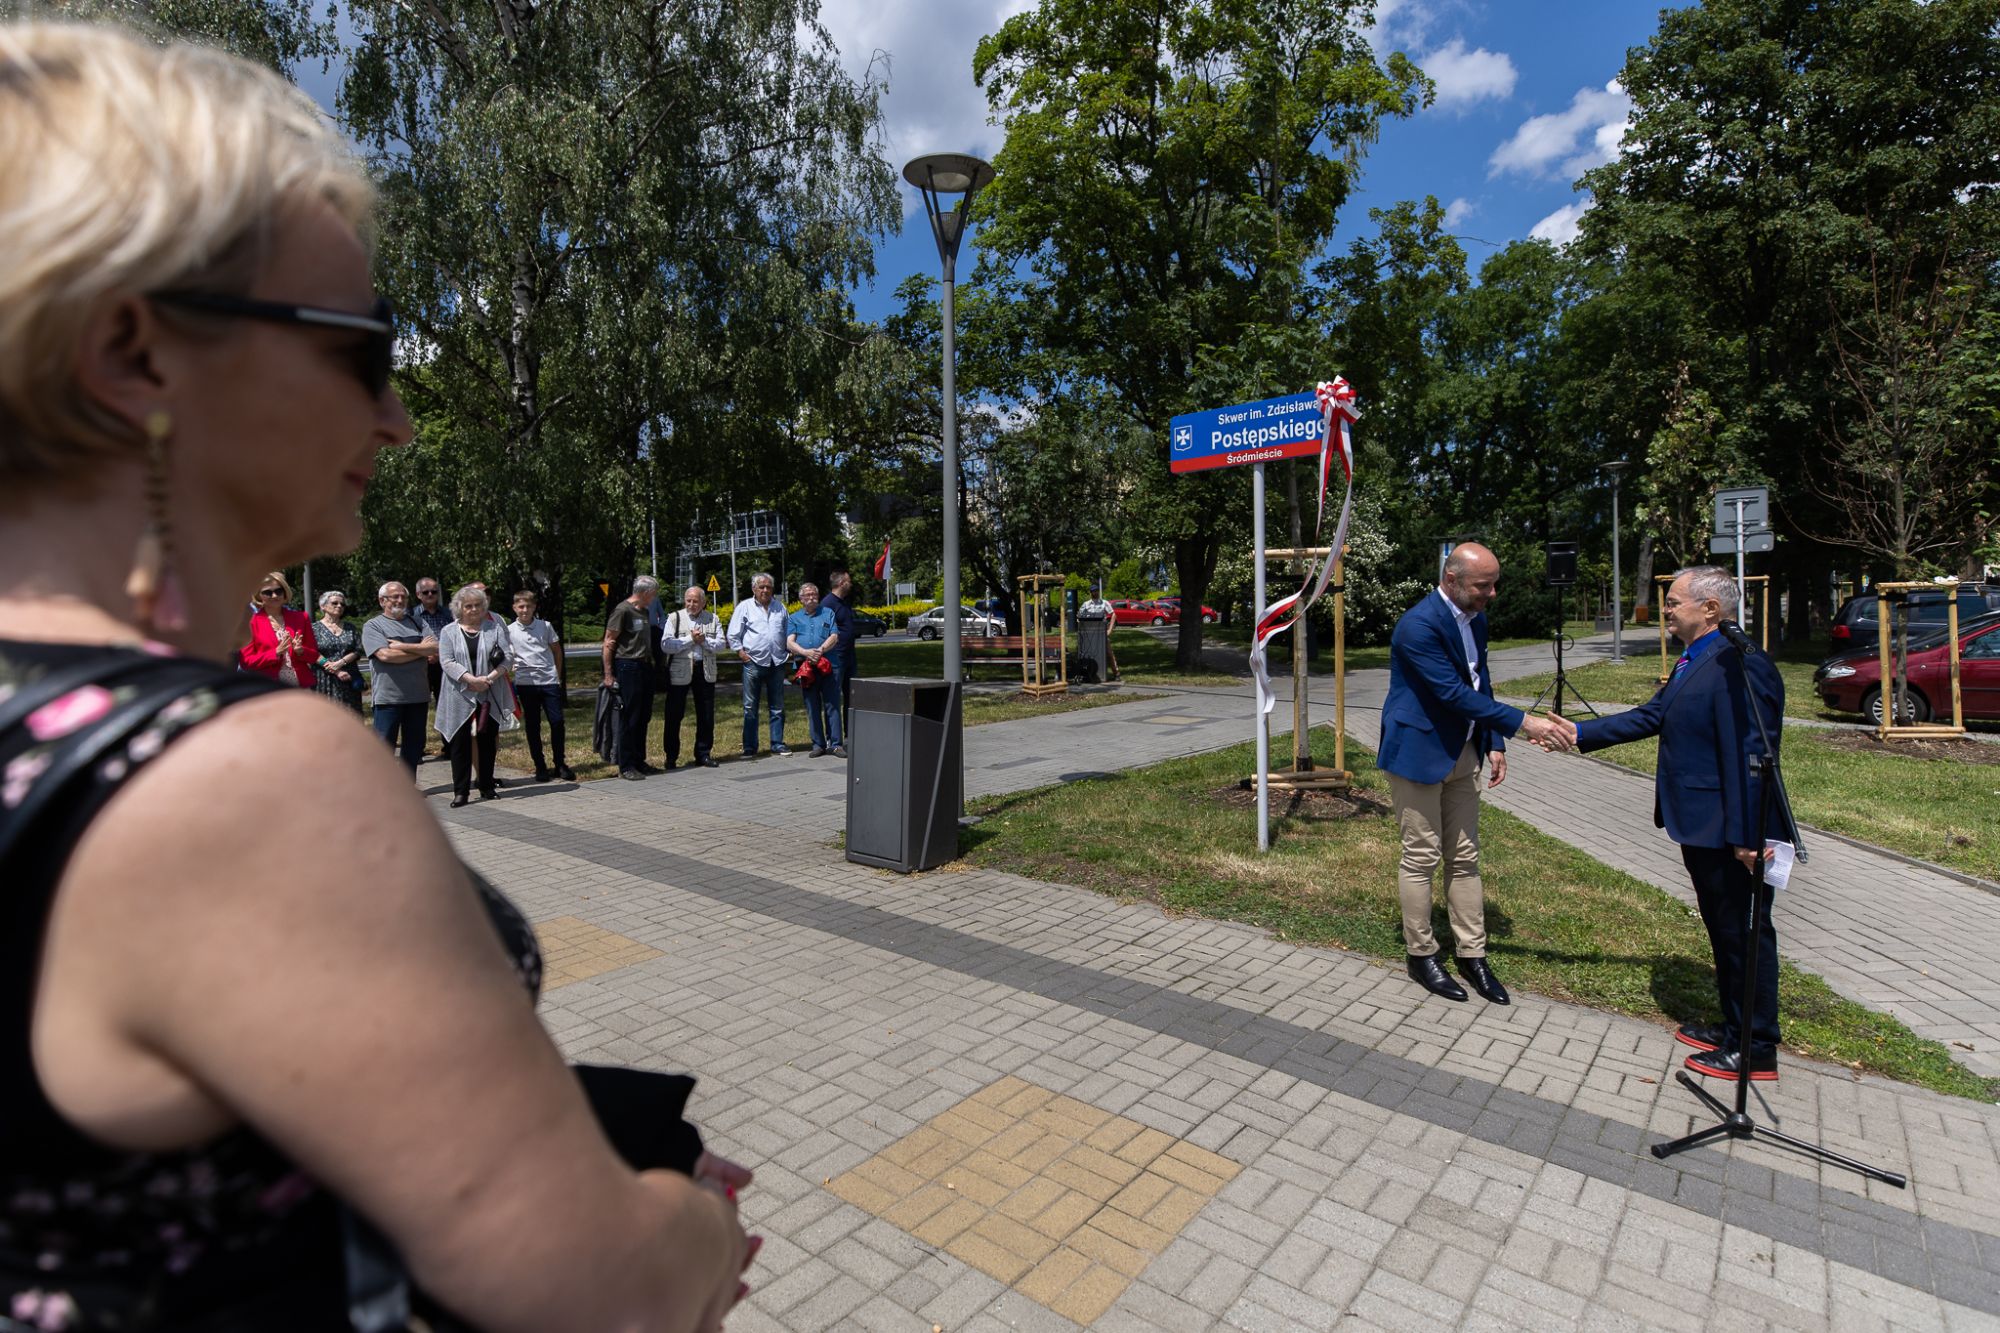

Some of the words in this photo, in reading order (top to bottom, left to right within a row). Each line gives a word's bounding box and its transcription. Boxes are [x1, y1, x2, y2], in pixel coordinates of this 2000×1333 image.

[1218, 410, 1247, 426] Skwer
[1250, 408, 1265, 420] im.
[1267, 399, 1318, 417] Zdzisława
[1211, 418, 1325, 450] Postępskiego
[1226, 449, 1283, 464] Śródmieście
